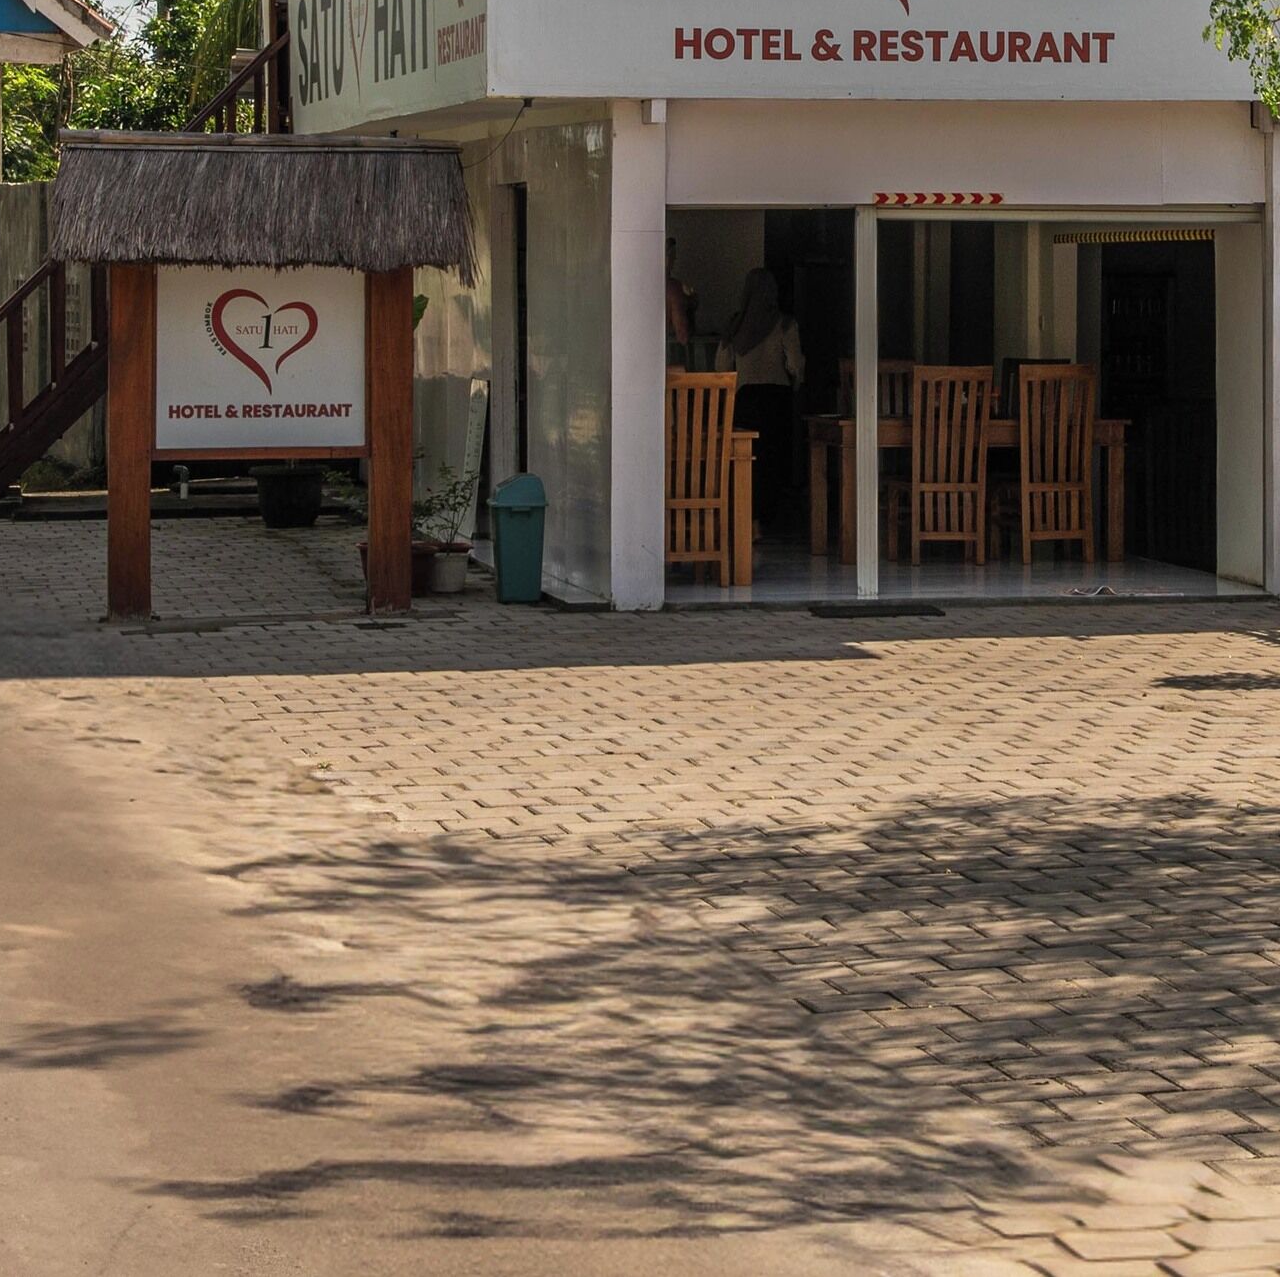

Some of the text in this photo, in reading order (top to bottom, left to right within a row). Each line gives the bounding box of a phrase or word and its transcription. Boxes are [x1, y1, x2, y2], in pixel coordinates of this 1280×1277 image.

[437, 13, 486, 66] RESTAURANT
[675, 27, 1115, 63] HOTEL & RESTAURANT
[235, 314, 298, 349] SATU 1 HATI
[168, 404, 353, 419] HOTEL & RESTAURANT
